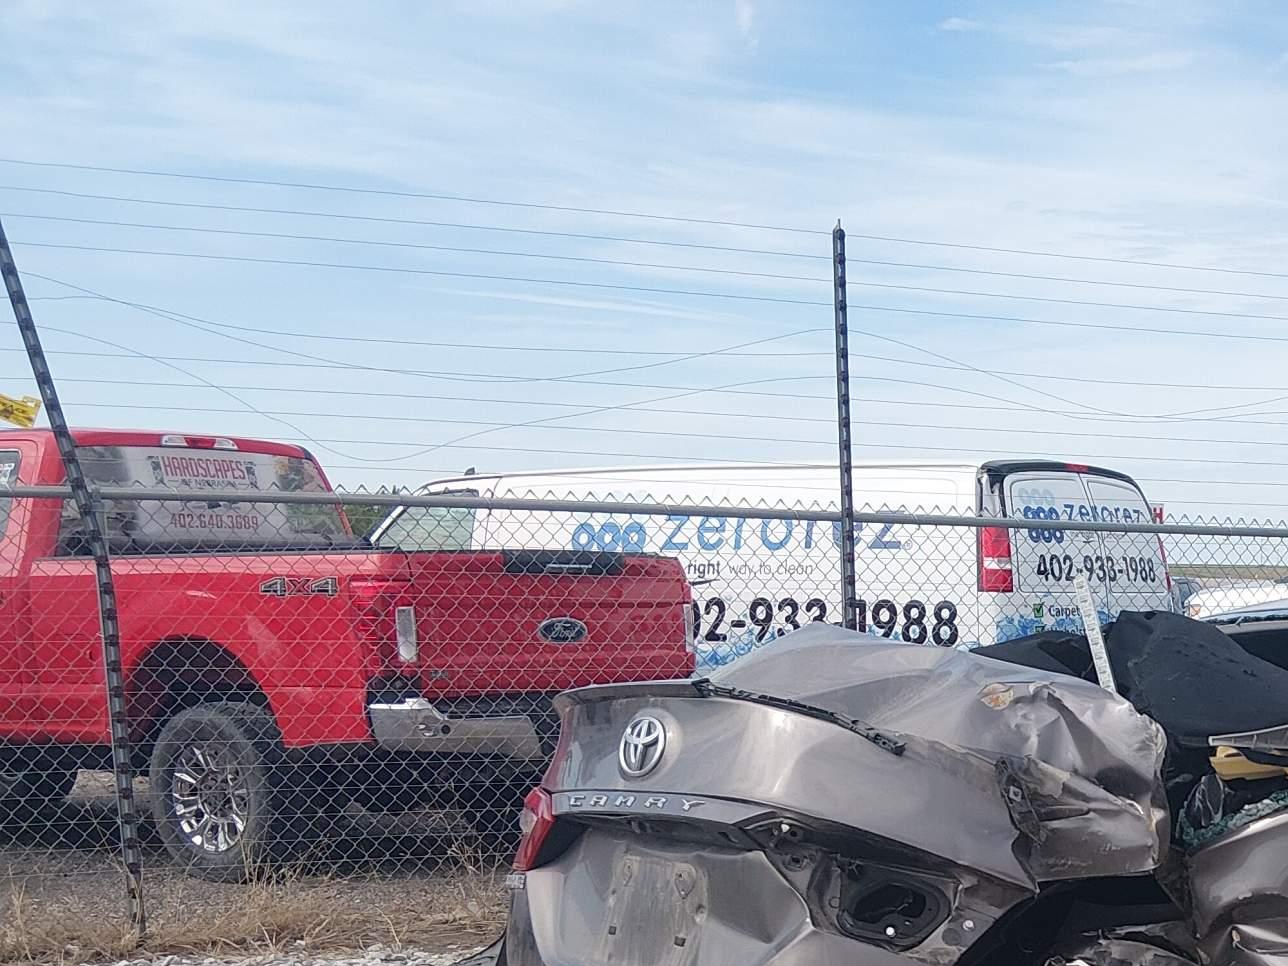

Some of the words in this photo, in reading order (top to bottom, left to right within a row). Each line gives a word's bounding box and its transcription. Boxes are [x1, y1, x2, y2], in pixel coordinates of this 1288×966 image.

[161, 456, 246, 480] HARDSCAPES
[687, 560, 720, 578] right
[728, 564, 754, 579] way
[759, 563, 772, 575] to
[776, 559, 814, 575] clean
[1037, 554, 1156, 583] 402-933-1988
[1048, 605, 1081, 619] Carpet
[550, 621, 582, 638] Ford
[567, 794, 706, 811] CAMRY
